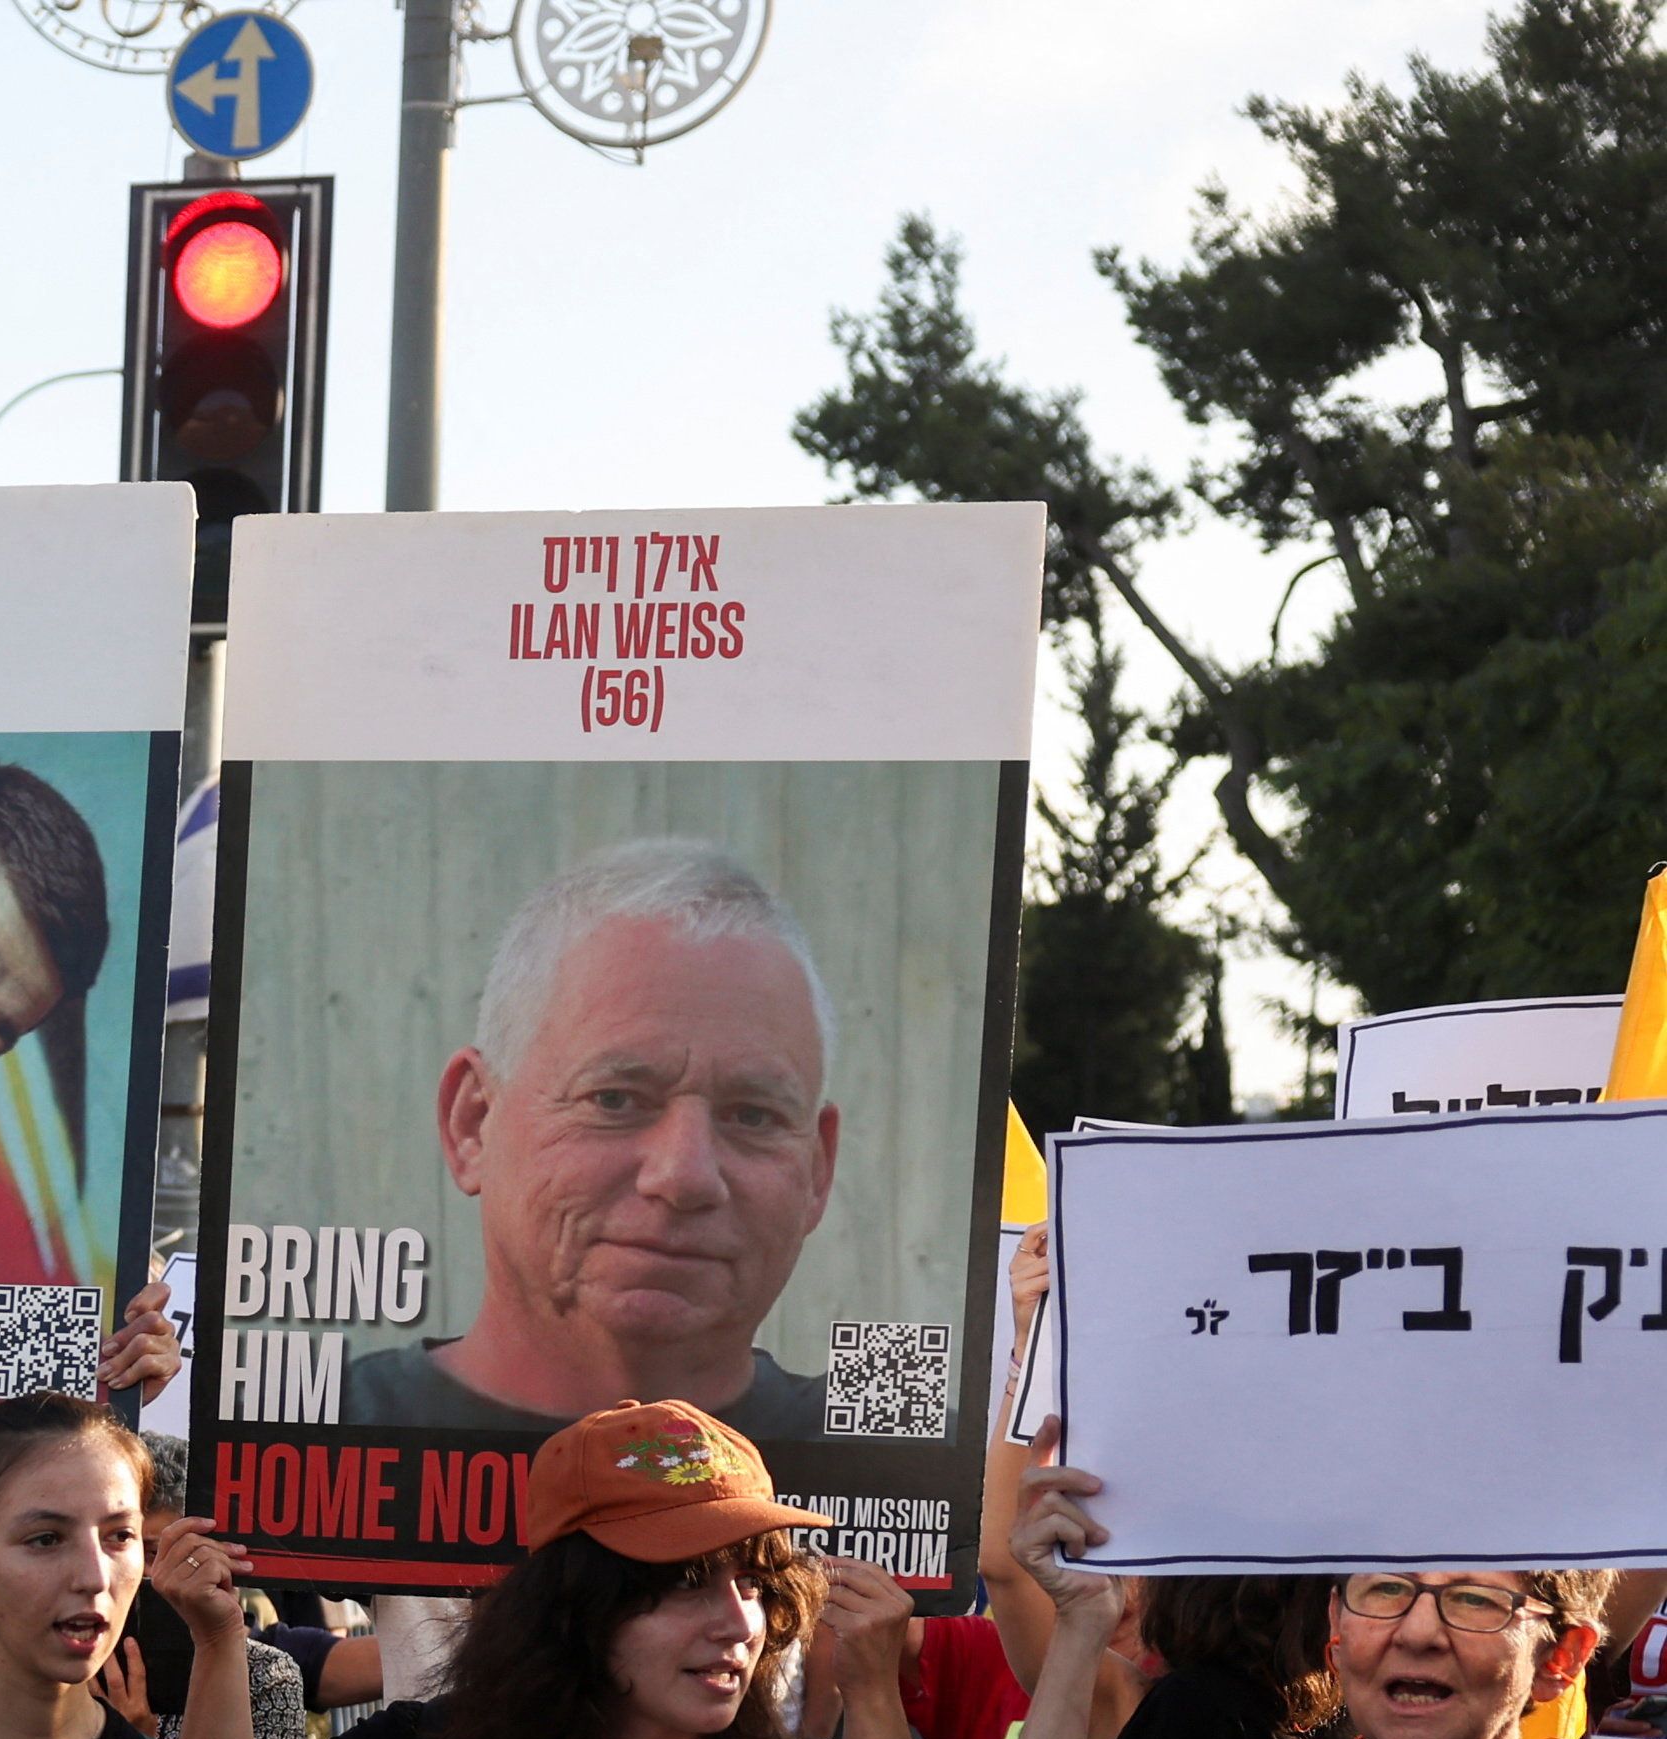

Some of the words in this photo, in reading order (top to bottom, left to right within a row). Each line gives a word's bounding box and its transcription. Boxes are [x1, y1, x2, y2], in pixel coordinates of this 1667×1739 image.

[543, 536, 619, 594] וייס
[634, 531, 720, 599] אילן
[509, 603, 599, 661] ILAN
[614, 601, 745, 660] WEISS
[581, 666, 665, 734] (56)
[223, 1223, 427, 1323] BRING
[1247, 1246, 1472, 1336] בייזר
[218, 1329, 343, 1425] HIM
[212, 1442, 400, 1545] HOME
[806, 1495, 849, 1527] AND
[854, 1497, 951, 1531] MISSING
